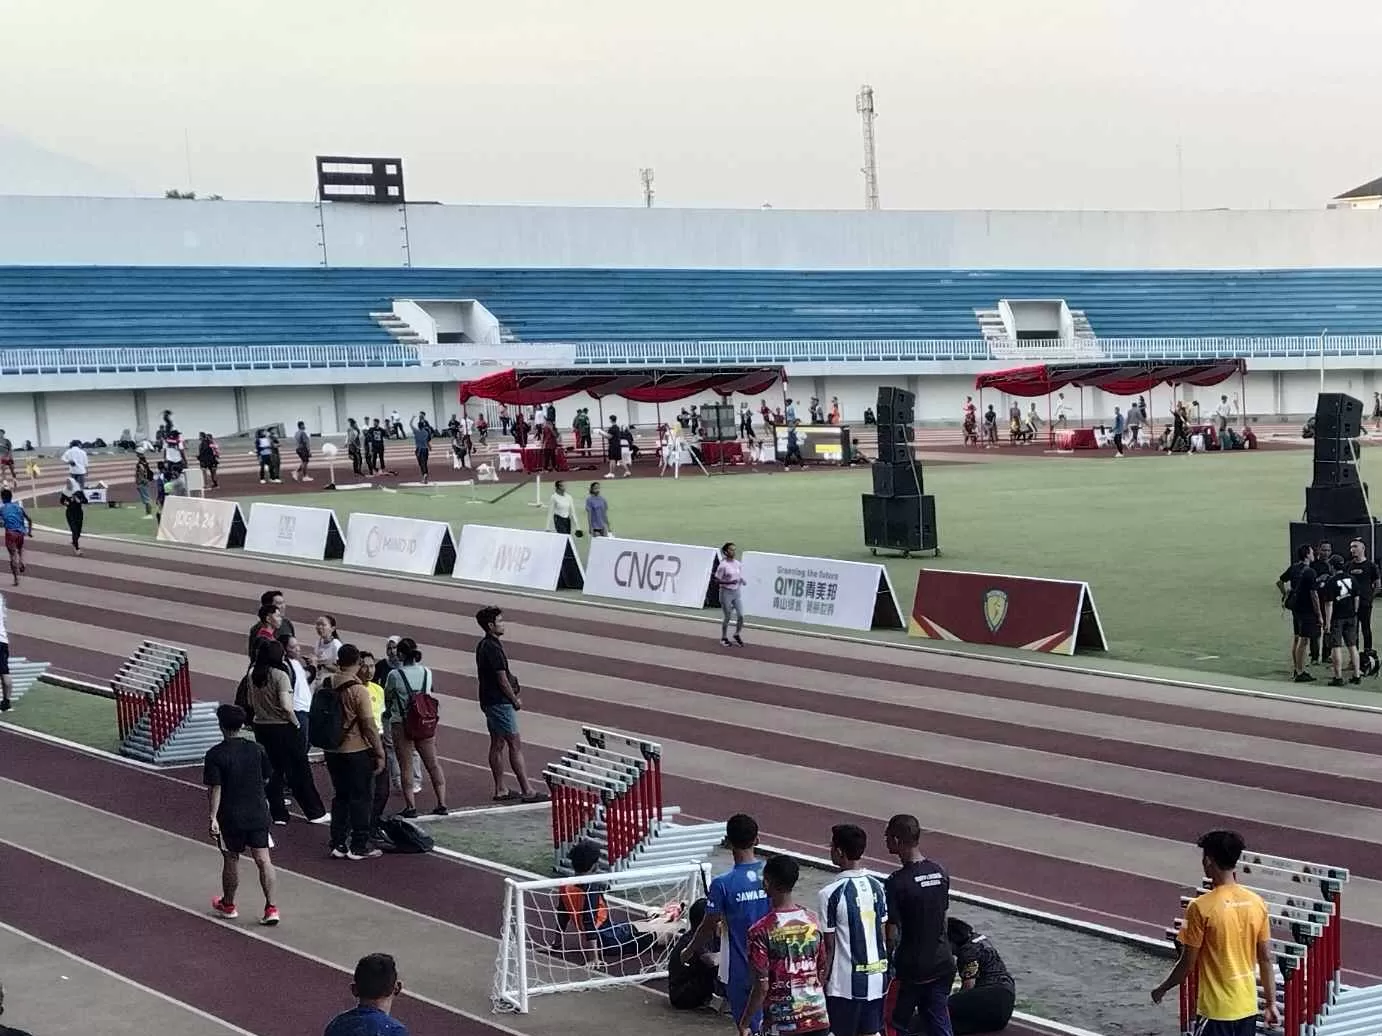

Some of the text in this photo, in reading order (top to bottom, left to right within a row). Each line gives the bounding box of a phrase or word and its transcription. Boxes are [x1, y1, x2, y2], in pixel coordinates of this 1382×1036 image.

[613, 550, 681, 593] CNGR
[774, 576, 805, 597] QMB
[736, 890, 758, 902] JAWA
